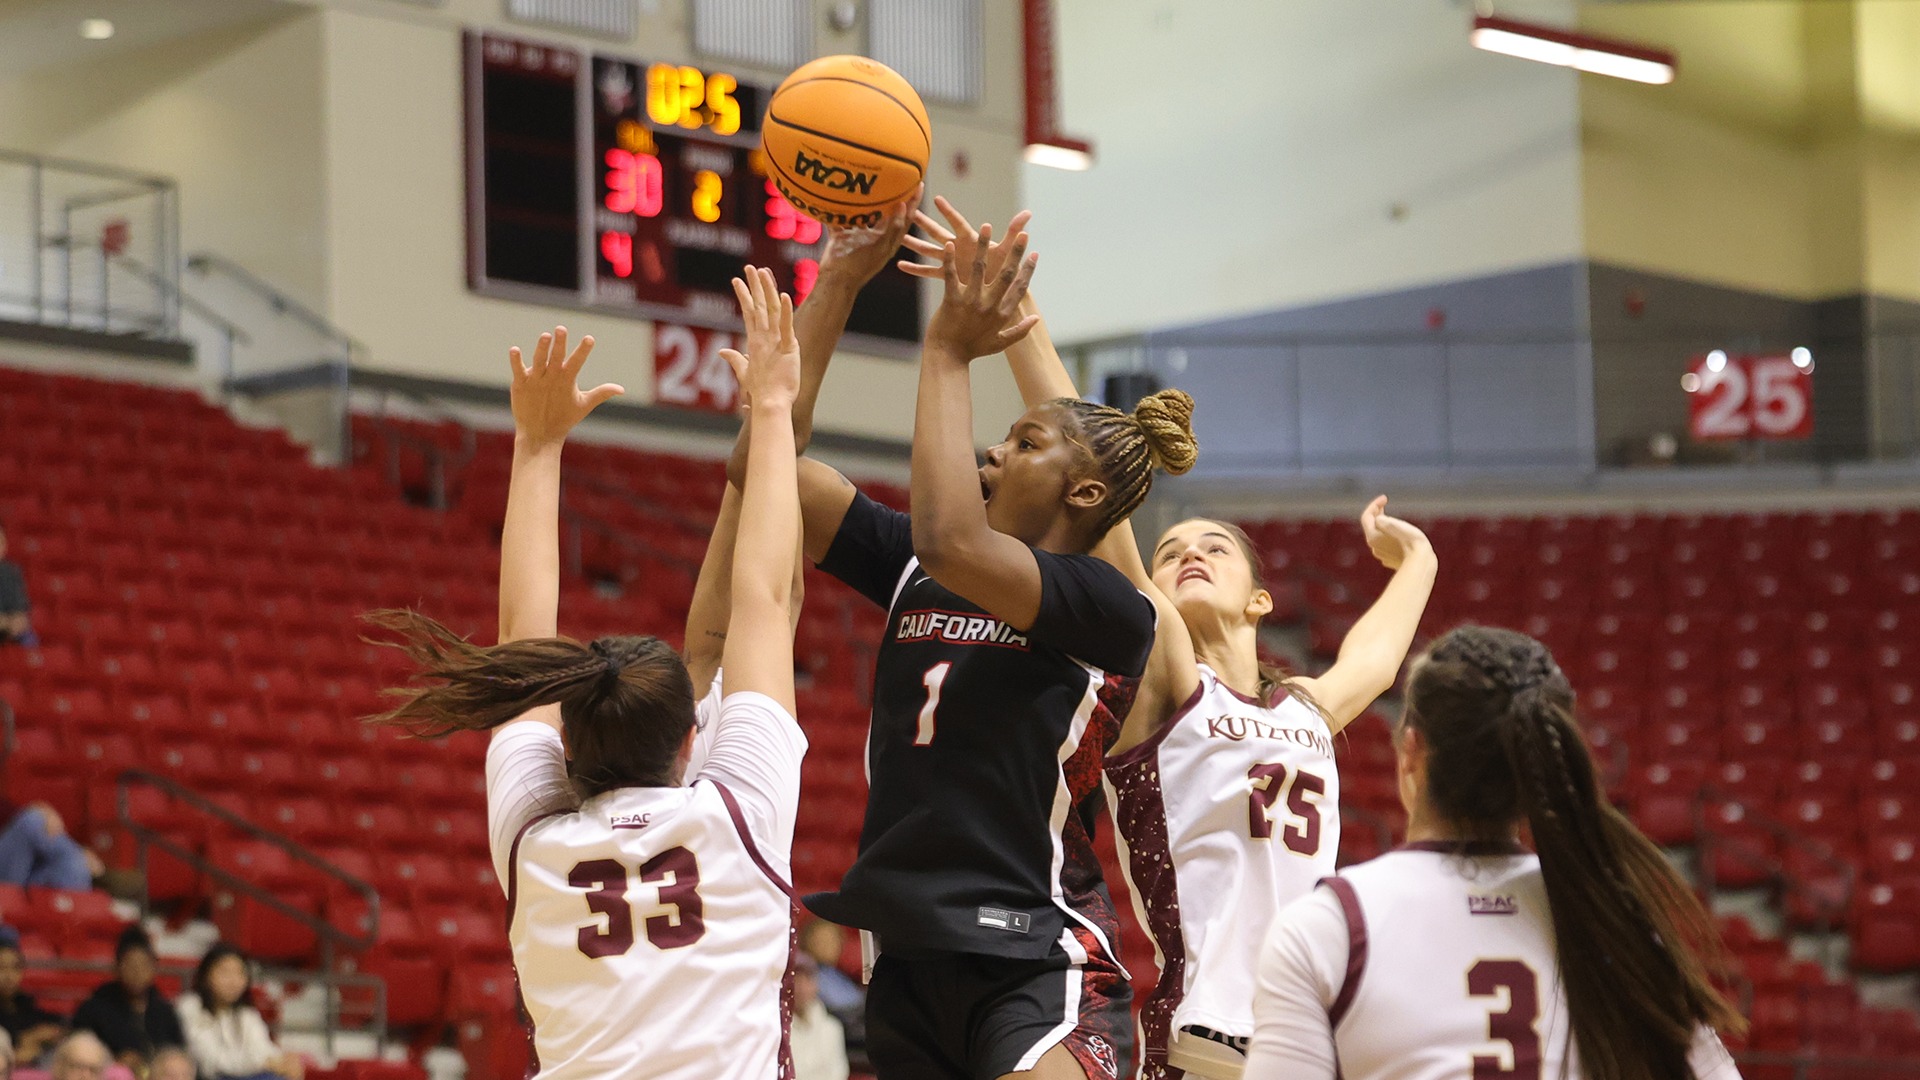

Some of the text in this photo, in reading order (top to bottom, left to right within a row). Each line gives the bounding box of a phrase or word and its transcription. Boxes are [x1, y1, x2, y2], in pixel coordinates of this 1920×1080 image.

[605, 148, 663, 217] 30
[692, 170, 722, 222] 2
[794, 150, 878, 195] NCAA
[659, 326, 739, 410] 24
[1697, 357, 1806, 436] 25
[913, 661, 951, 746] 1
[610, 813, 651, 825] PSAC
[1247, 762, 1326, 857] 25
[568, 845, 706, 960] 33
[1014, 917, 1021, 926] L
[1467, 960, 1541, 1080] 3
